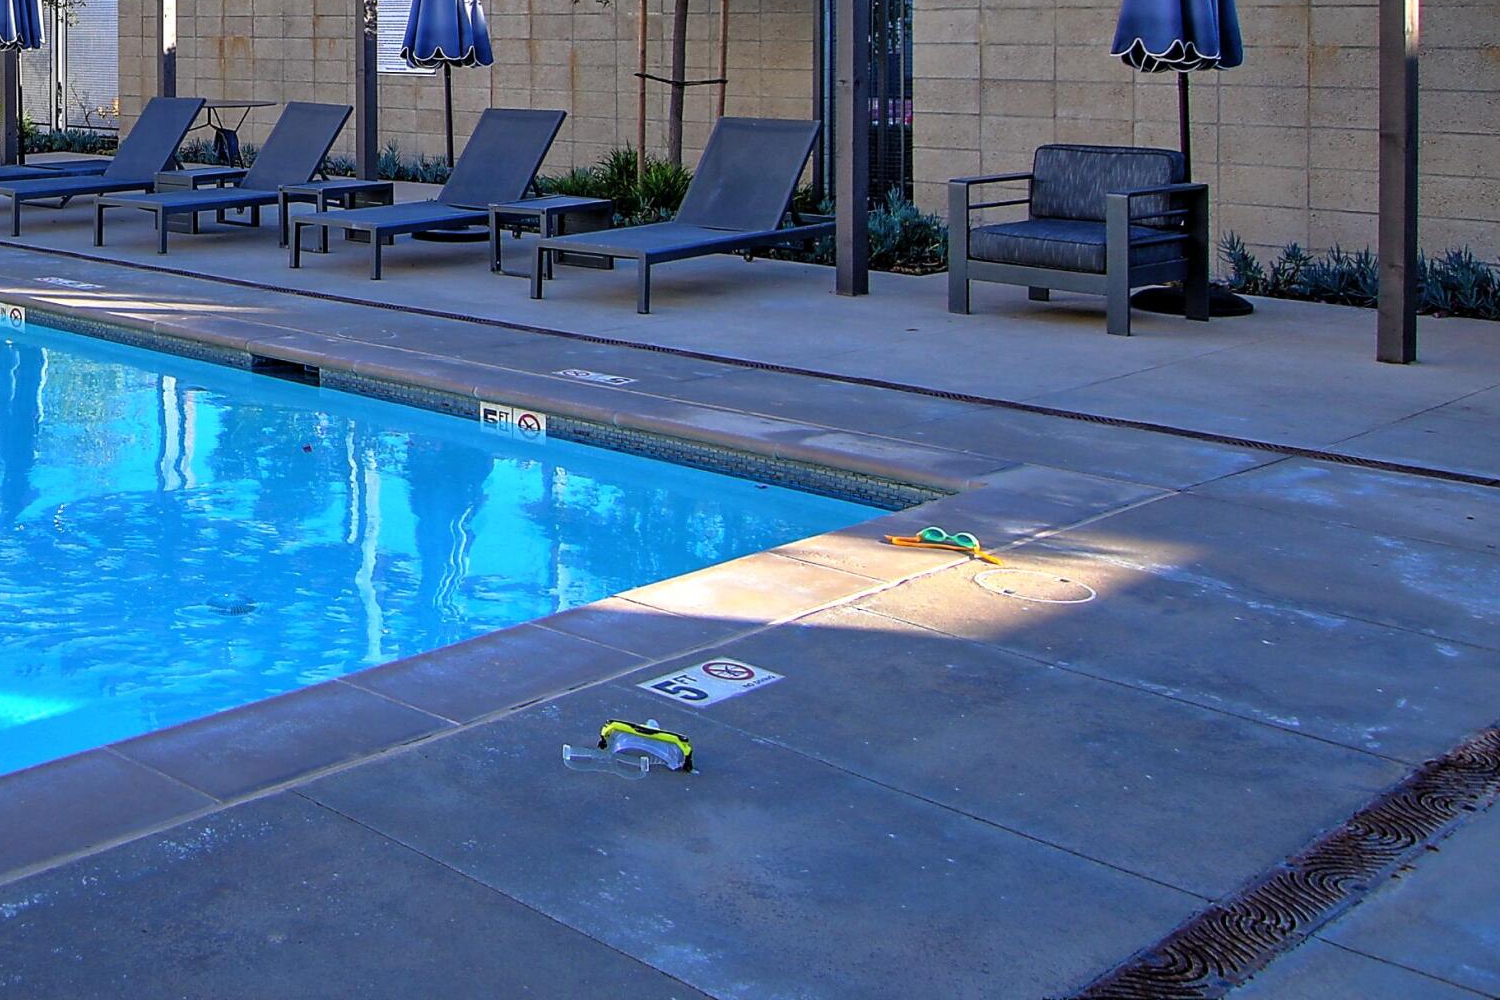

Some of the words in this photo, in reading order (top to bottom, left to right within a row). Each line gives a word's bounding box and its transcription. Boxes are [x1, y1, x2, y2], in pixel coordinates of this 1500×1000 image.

[483, 408, 498, 424] 5
[673, 674, 697, 685] FT
[651, 680, 708, 700] 5
